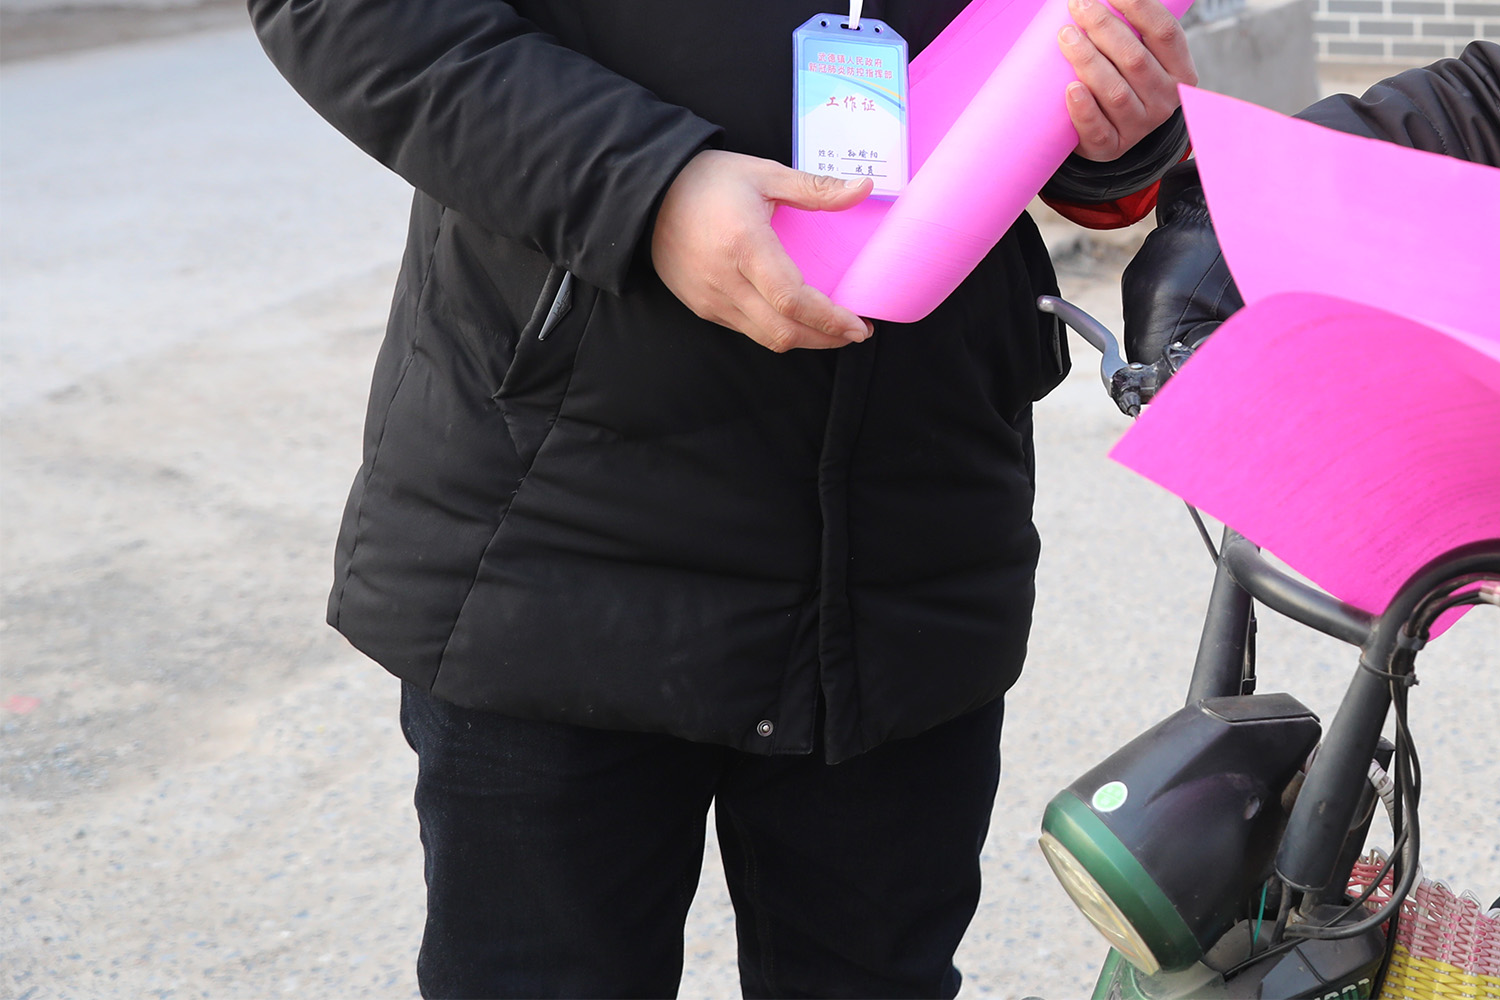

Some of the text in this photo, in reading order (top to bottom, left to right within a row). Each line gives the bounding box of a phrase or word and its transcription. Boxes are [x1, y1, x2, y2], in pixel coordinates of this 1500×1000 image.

[808, 62, 893, 79] 新冠肺炎防控指挥部
[826, 96, 876, 112] 工作证
